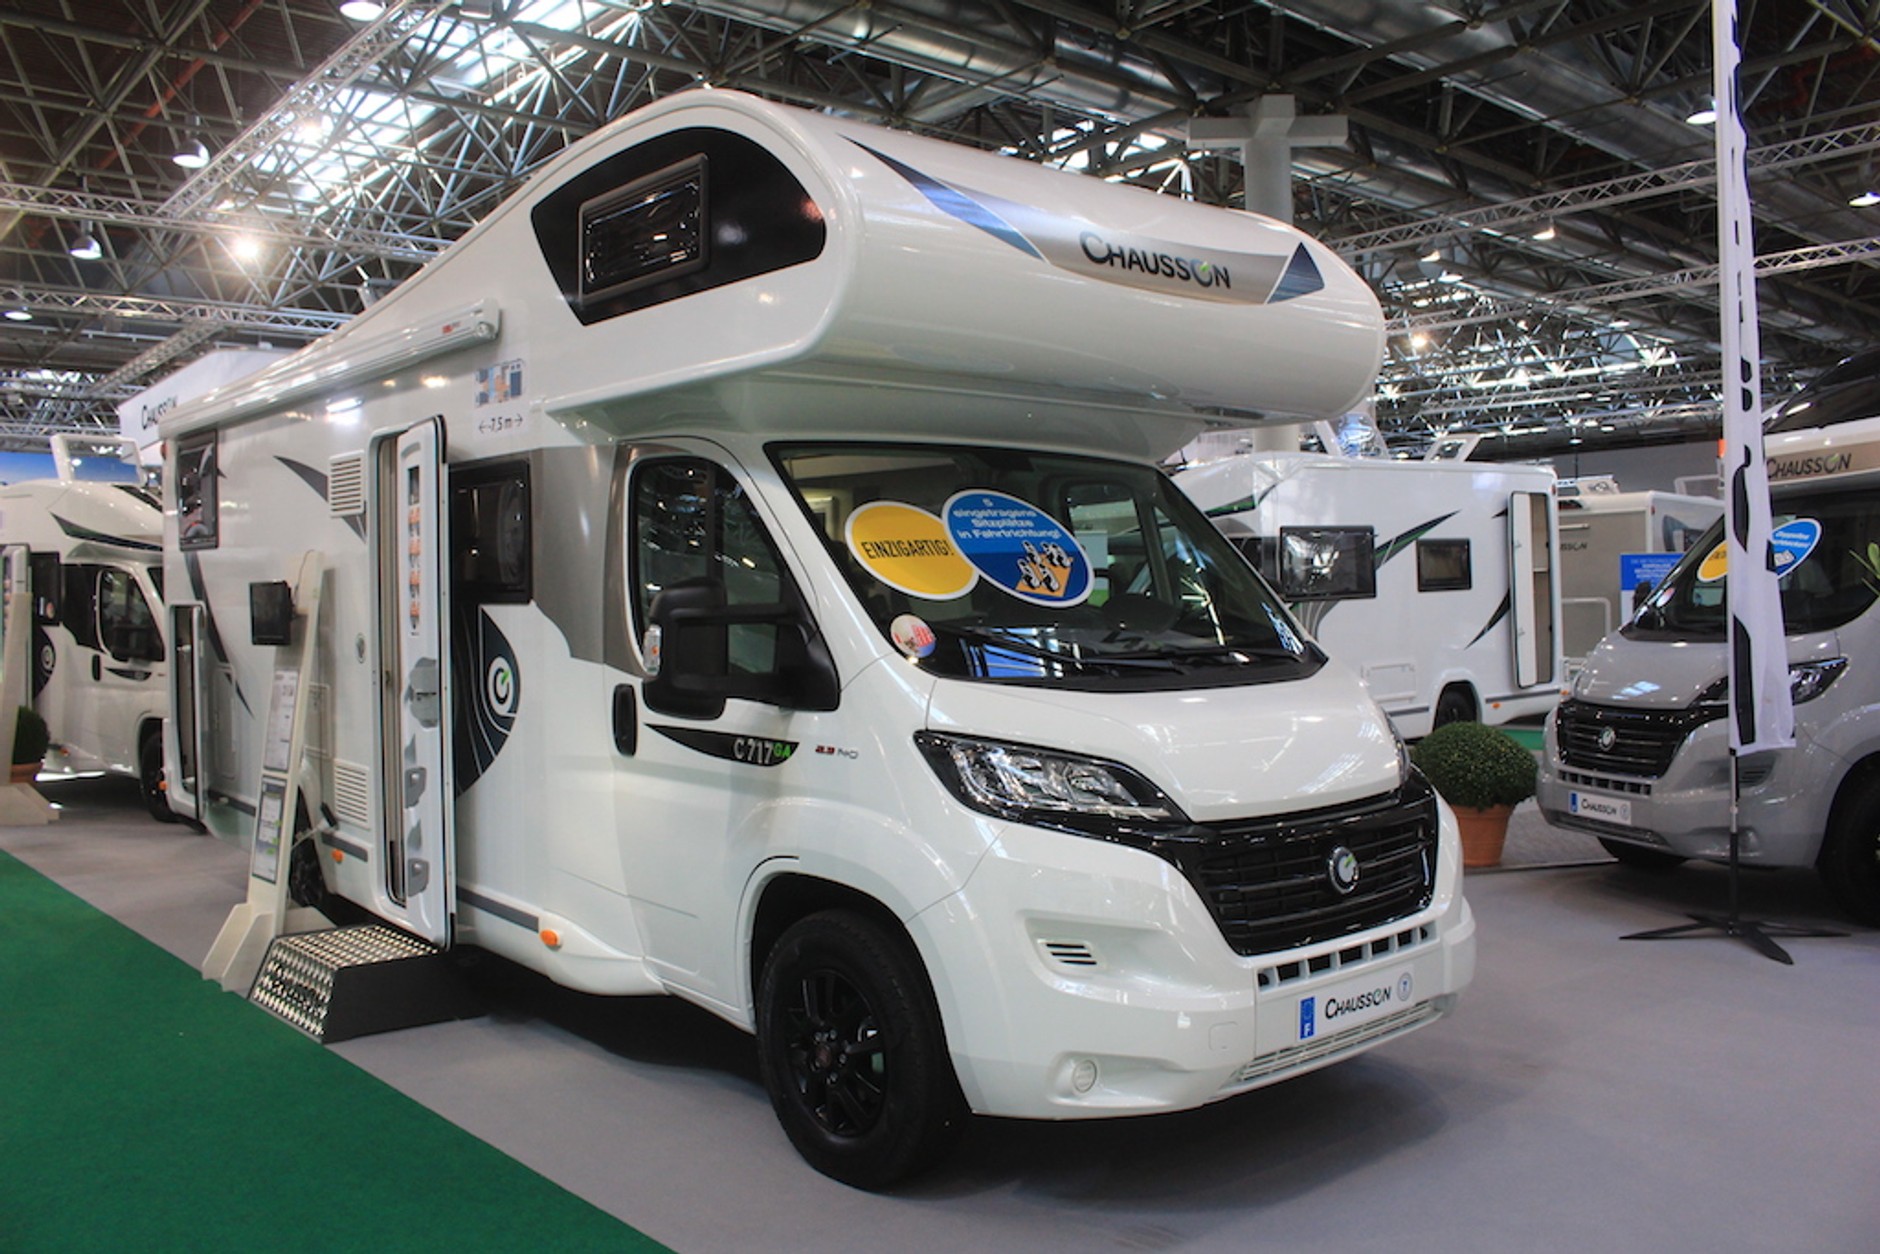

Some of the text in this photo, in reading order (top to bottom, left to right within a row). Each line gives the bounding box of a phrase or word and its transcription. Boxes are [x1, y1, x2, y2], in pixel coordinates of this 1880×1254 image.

[1079, 230, 1231, 289] CHAUSSON
[860, 538, 955, 560] EINZIGARTIG!
[958, 530, 973, 540] in
[1325, 985, 1392, 1019] CHAUSSON
